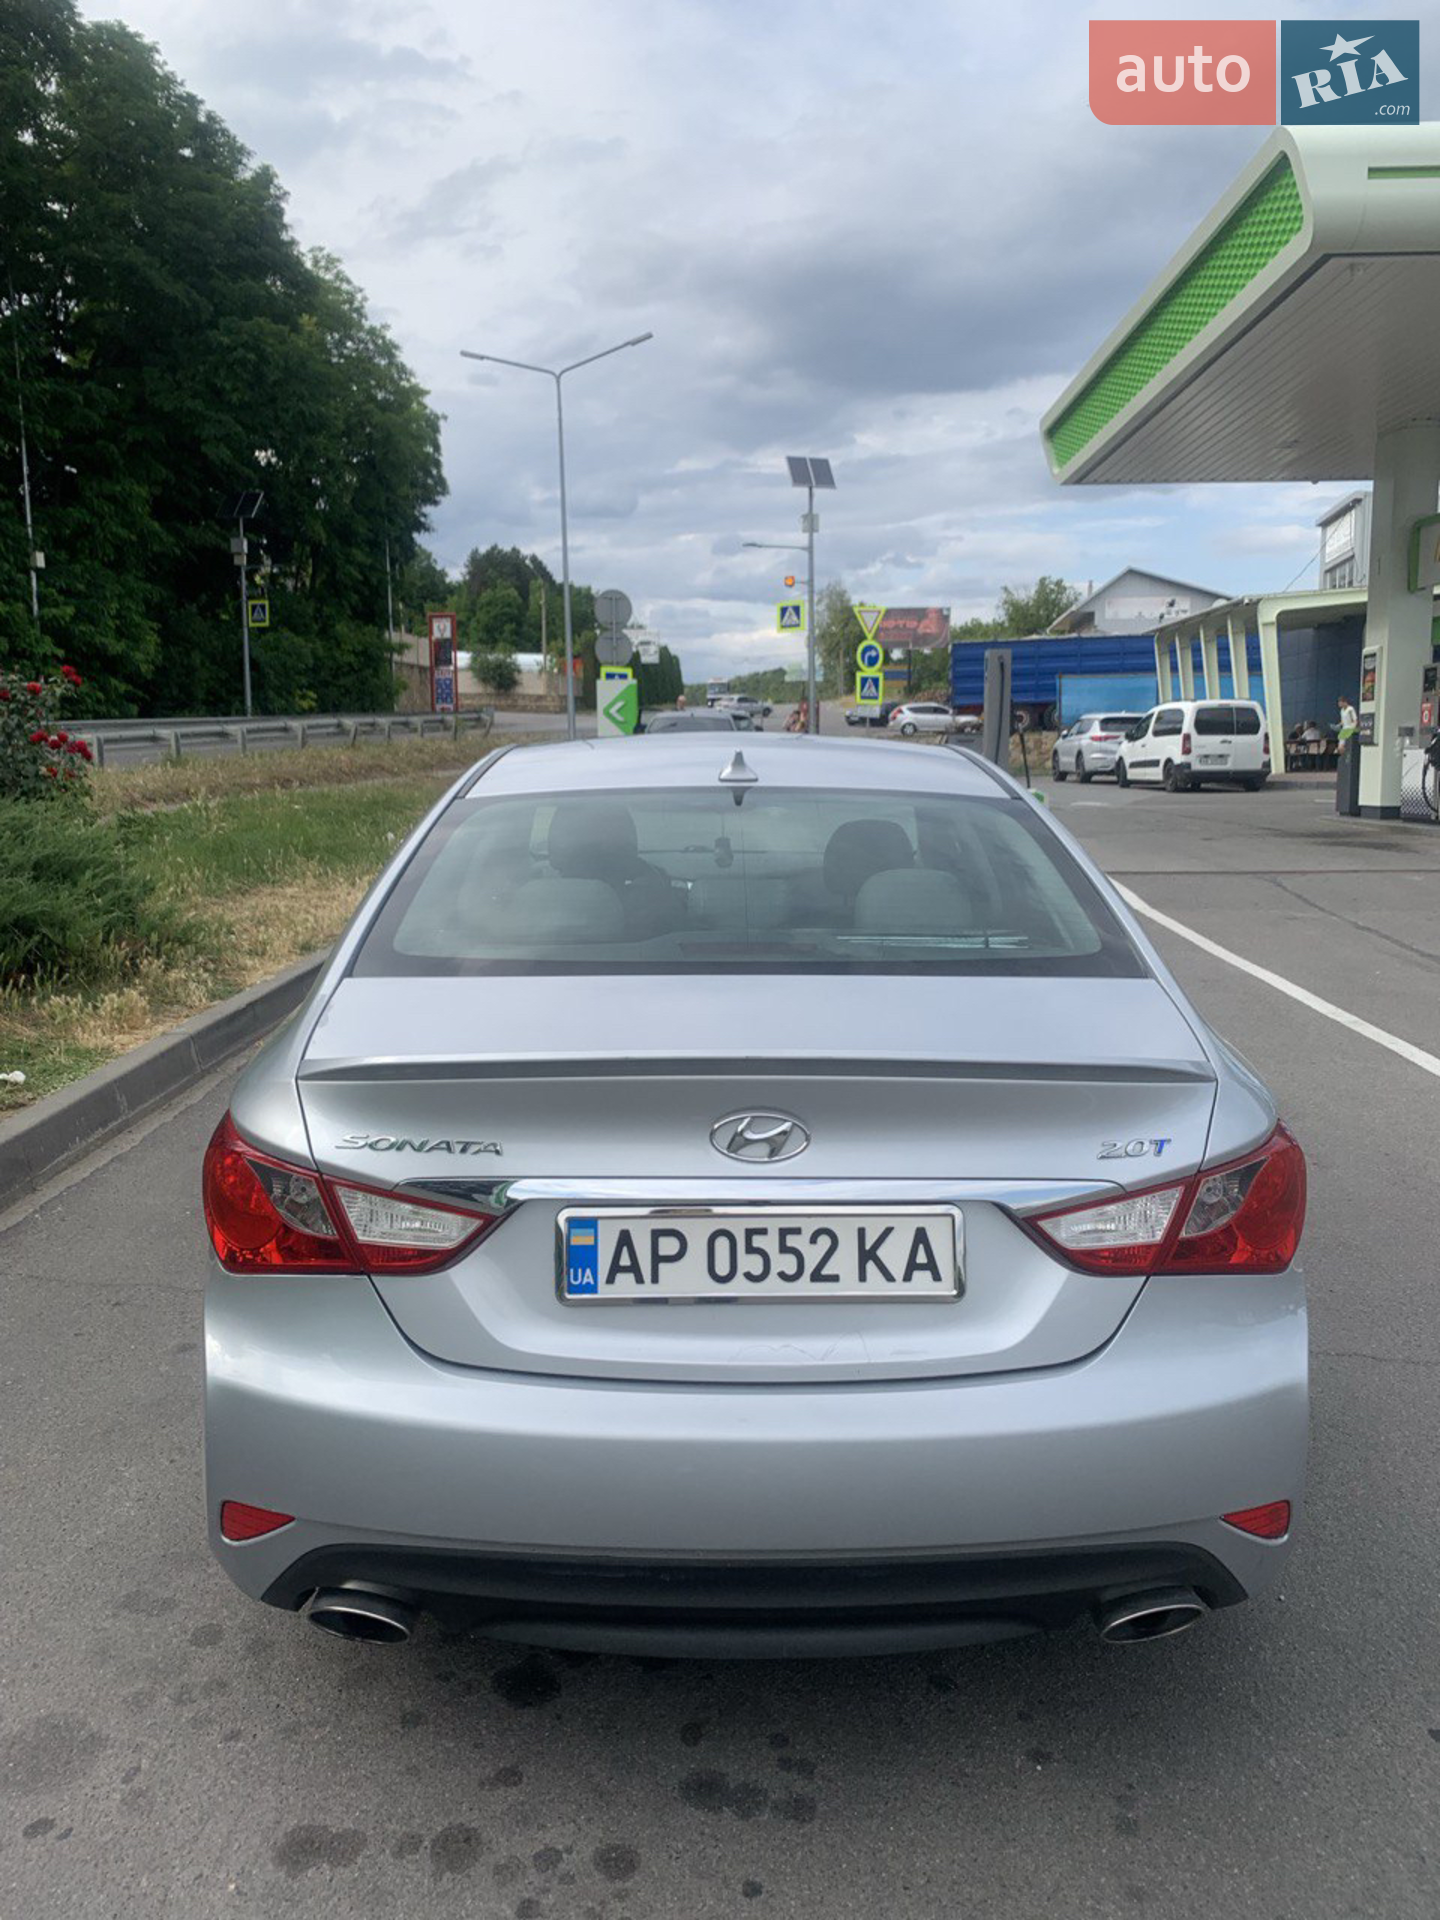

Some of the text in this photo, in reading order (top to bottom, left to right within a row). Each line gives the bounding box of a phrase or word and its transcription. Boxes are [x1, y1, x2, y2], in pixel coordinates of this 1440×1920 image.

[335, 1133, 503, 1156] SONATA
[604, 1226, 943, 1285] AP 0552 KA
[569, 1267, 595, 1285] UA
